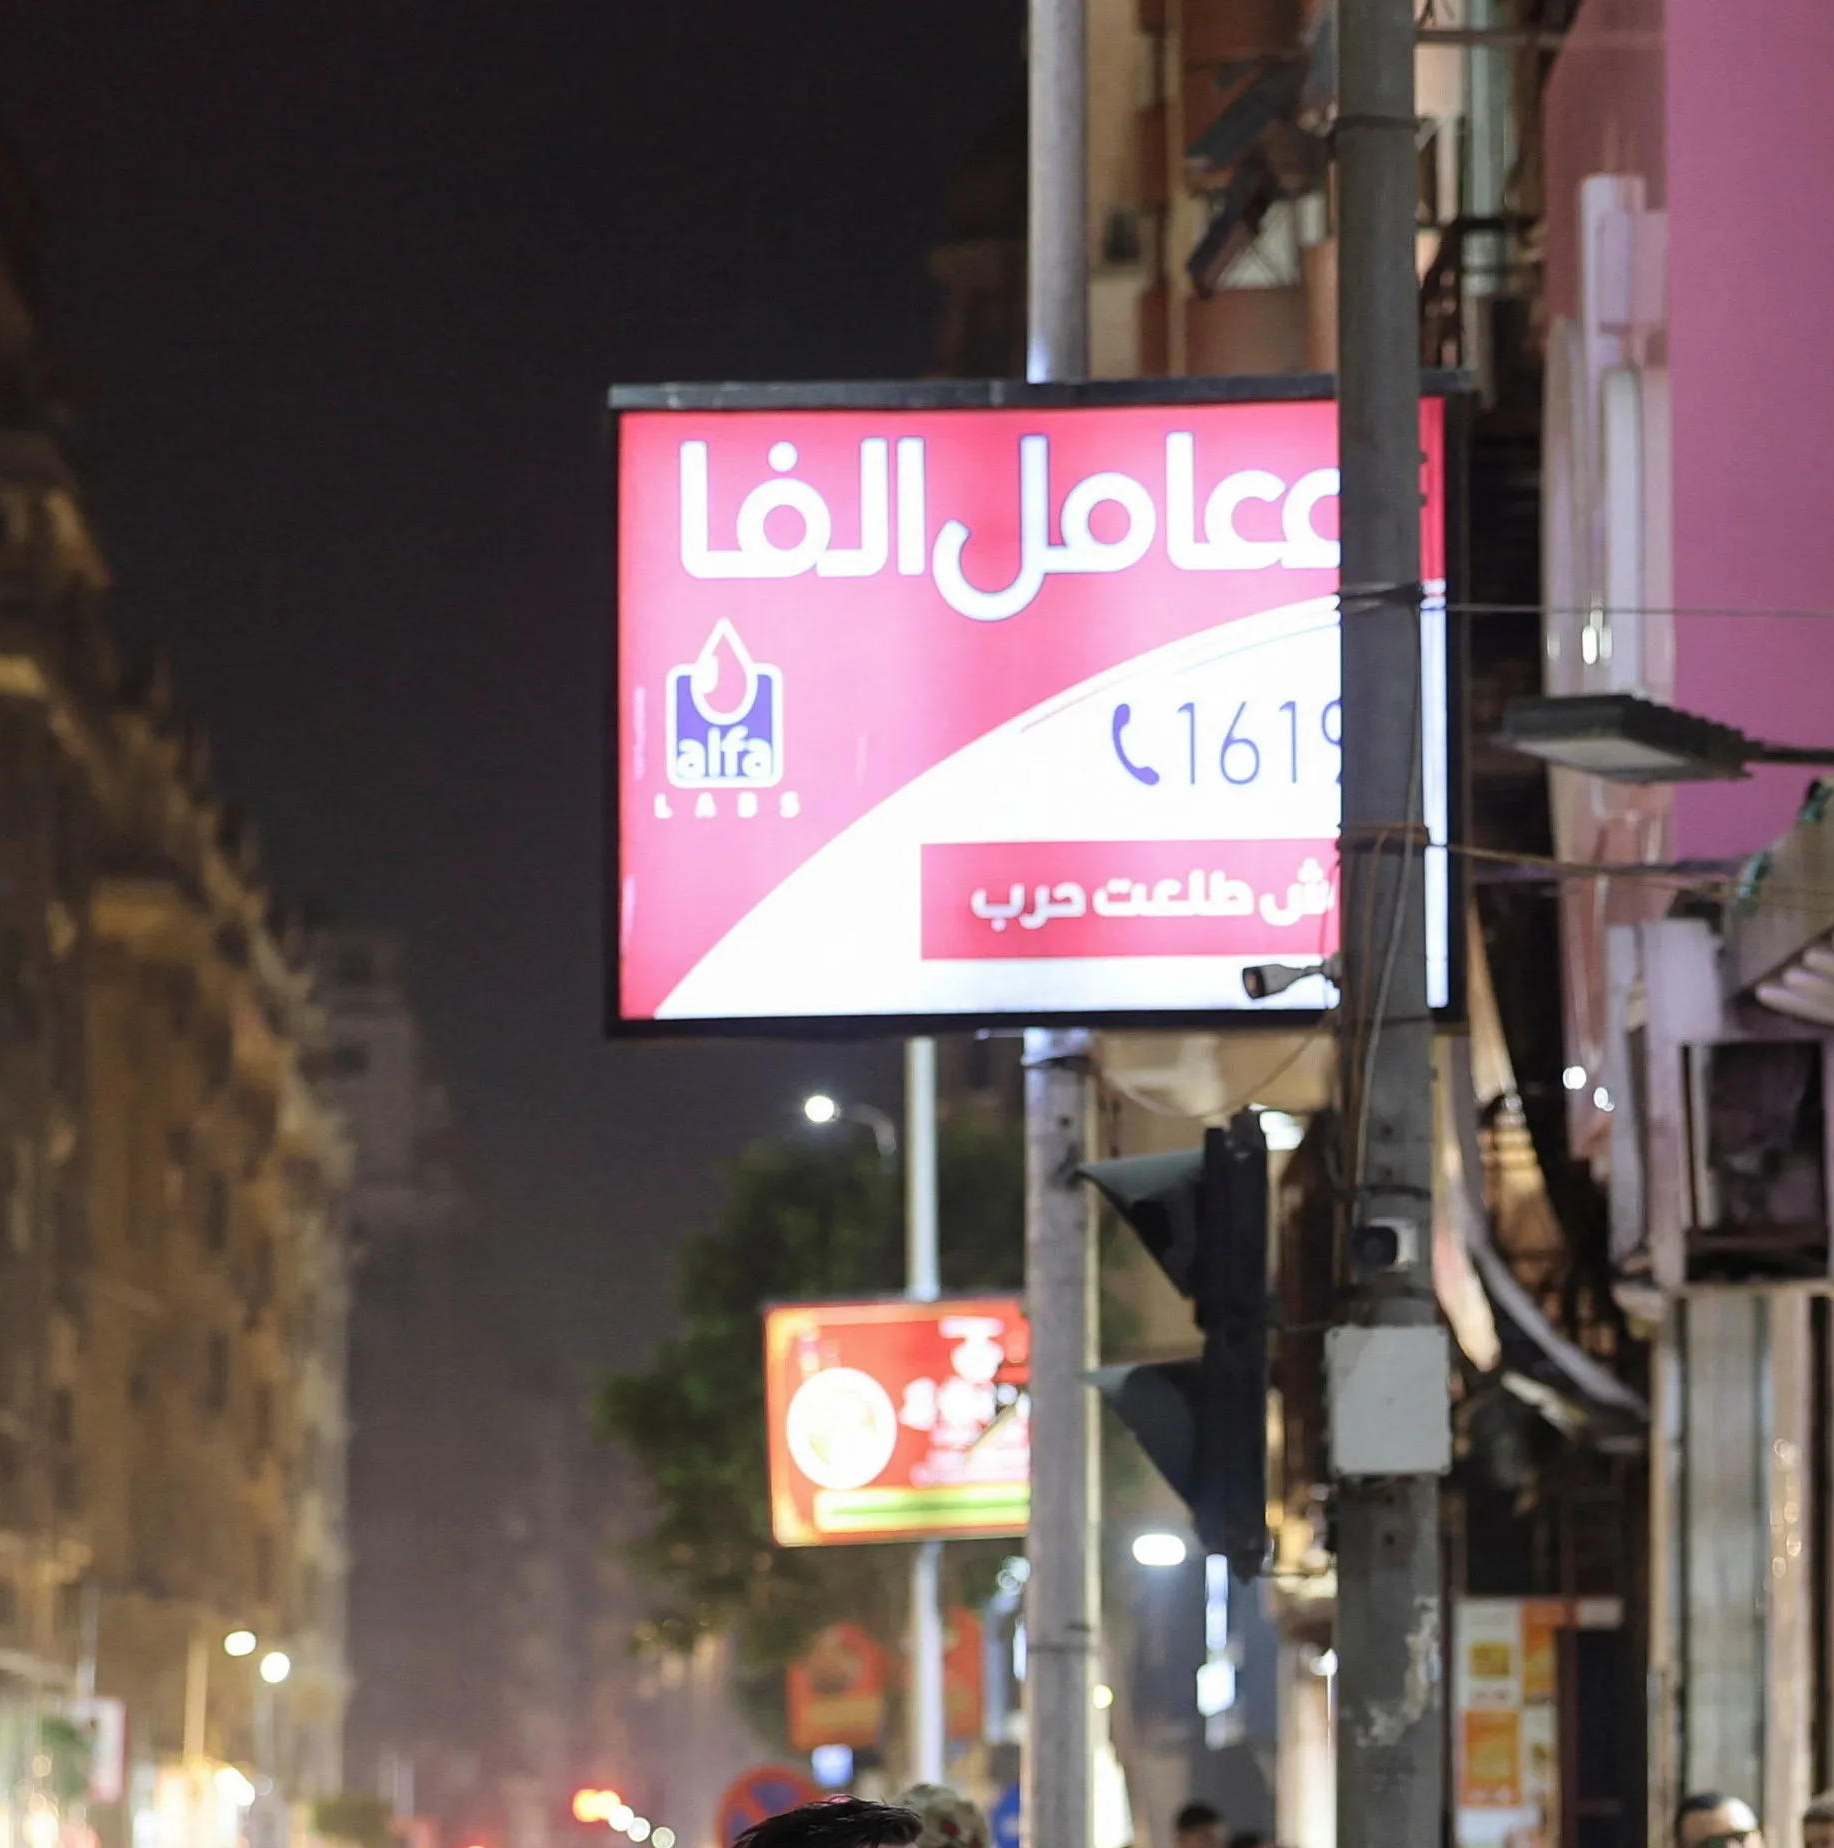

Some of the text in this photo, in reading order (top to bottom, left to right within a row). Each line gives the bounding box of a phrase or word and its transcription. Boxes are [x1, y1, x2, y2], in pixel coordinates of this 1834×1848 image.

[676, 724, 776, 780] alfa
[970, 880, 1087, 932] حرب
[1092, 867, 1255, 917] طلعت
